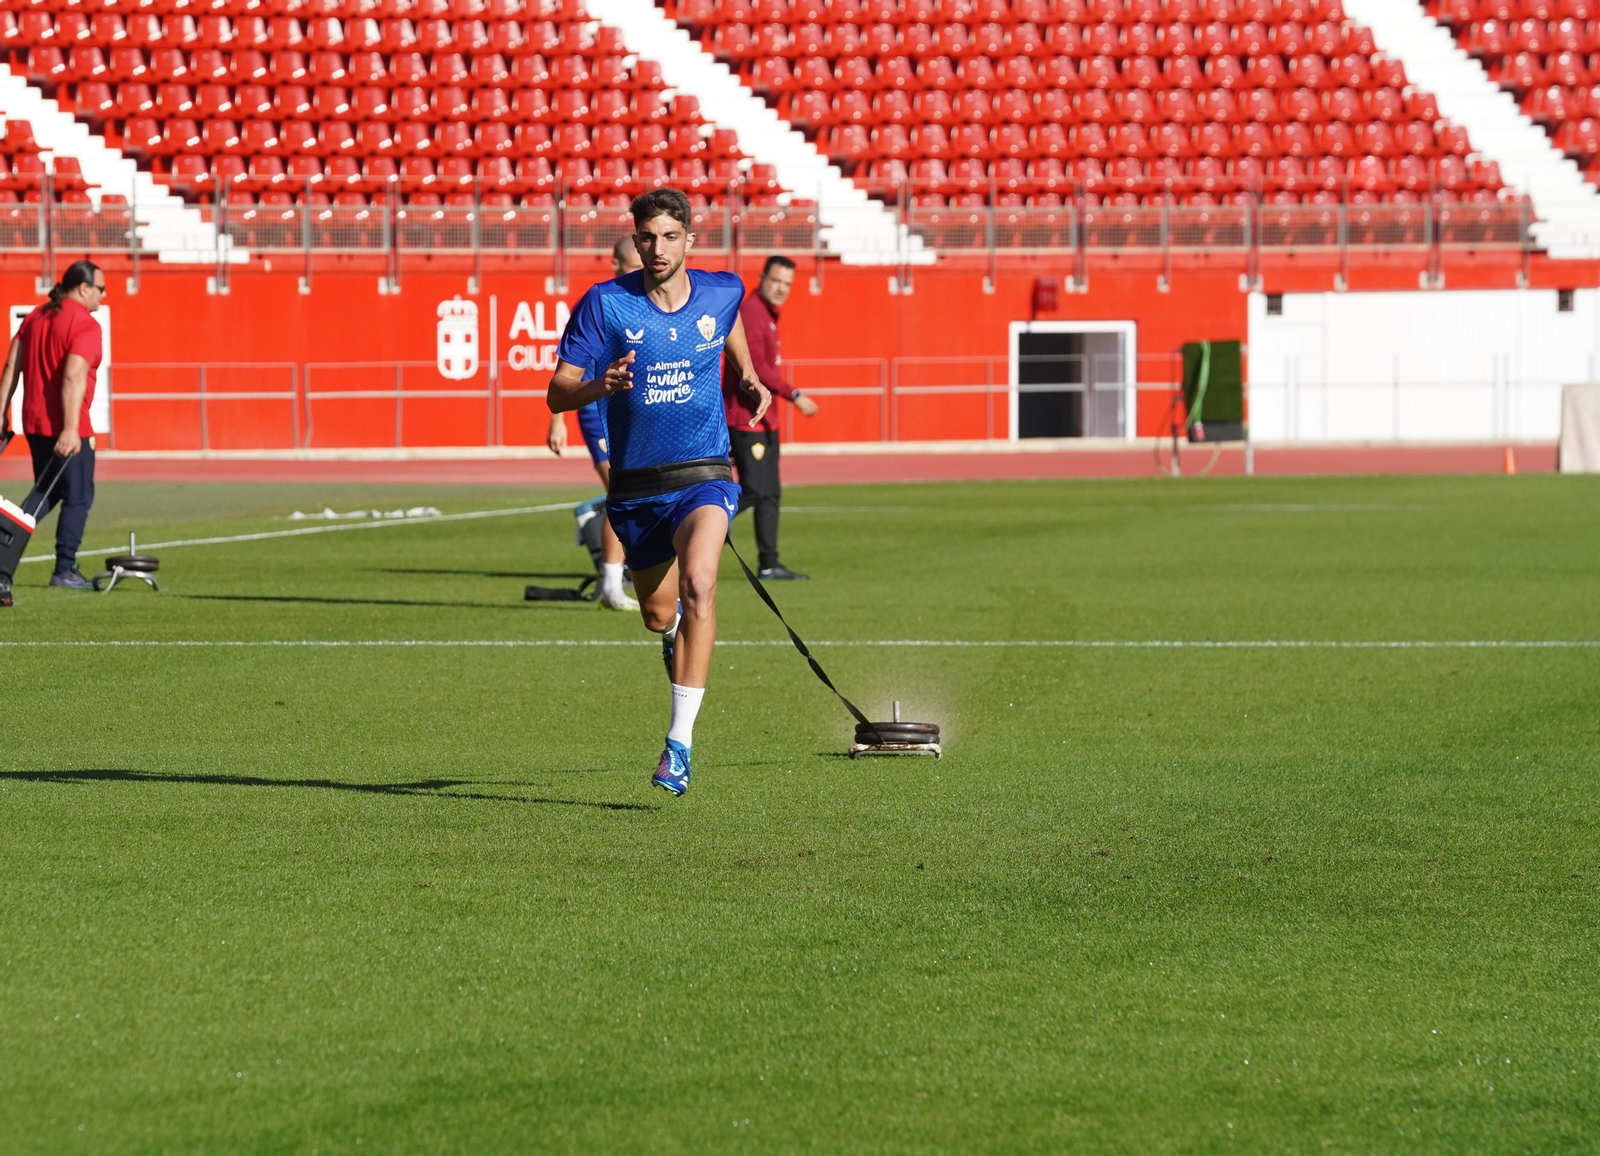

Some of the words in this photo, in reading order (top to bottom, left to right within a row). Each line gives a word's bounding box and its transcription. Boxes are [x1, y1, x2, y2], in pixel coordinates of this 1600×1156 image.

[669, 327, 677, 341] 3
[654, 359, 691, 370] Almería
[657, 369, 686, 386] vida
